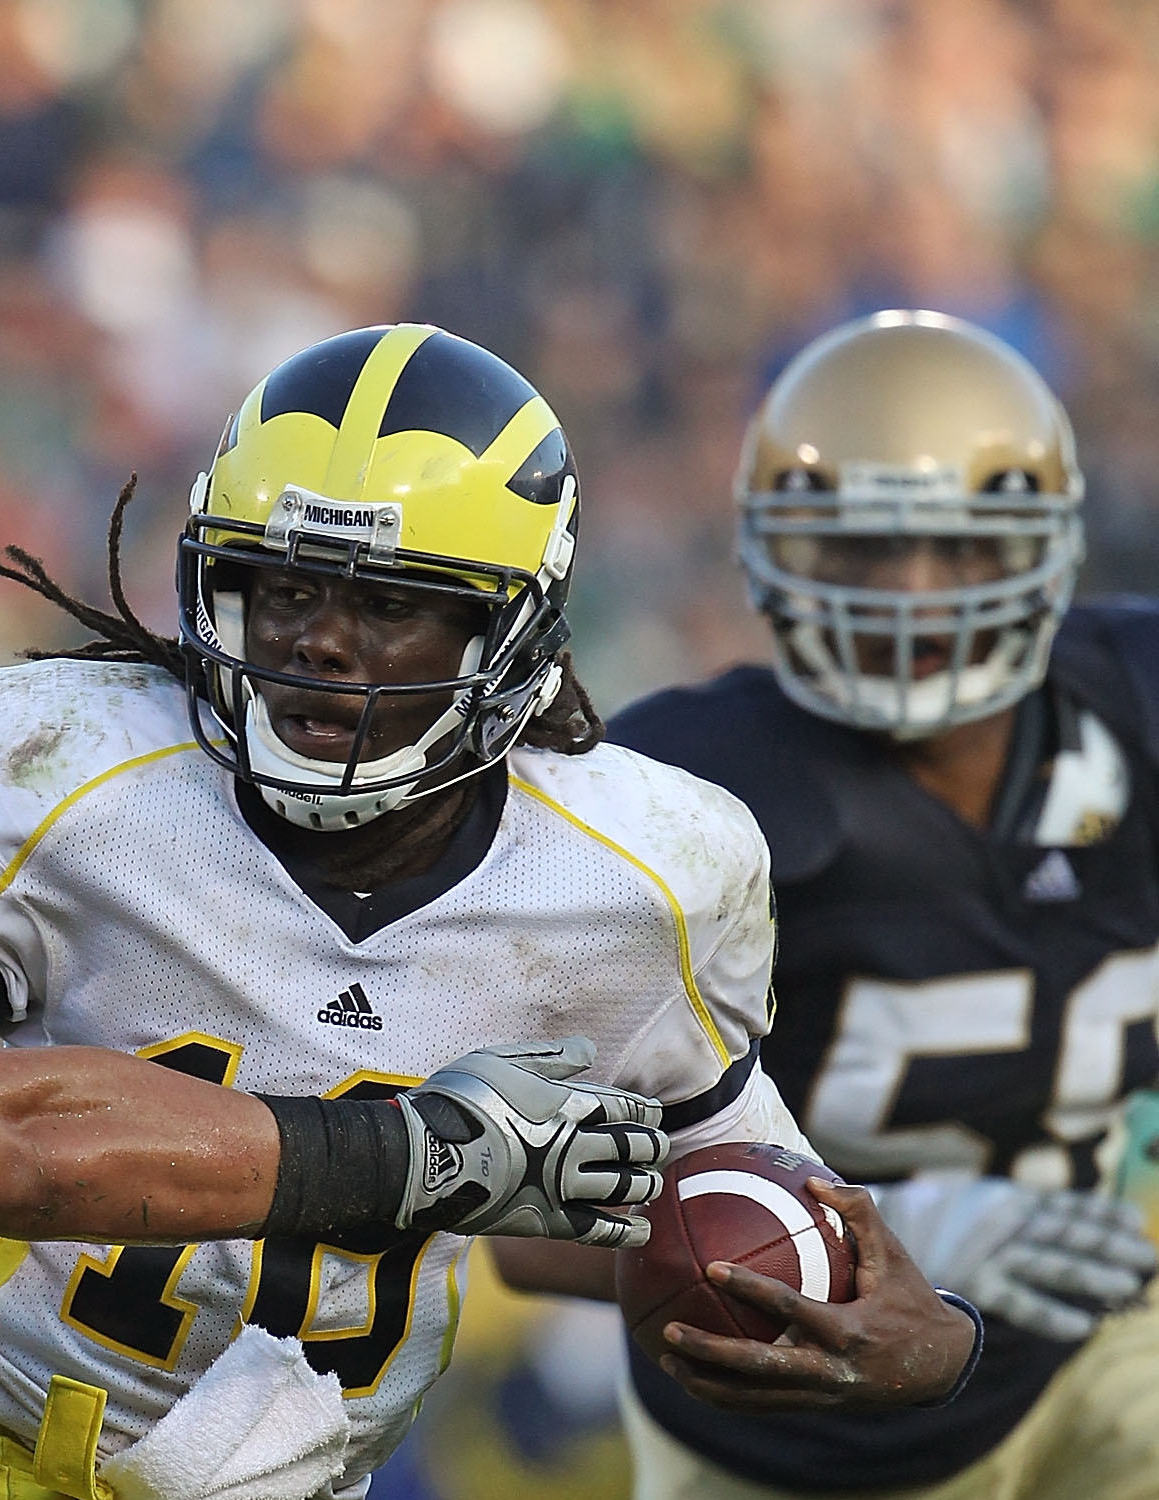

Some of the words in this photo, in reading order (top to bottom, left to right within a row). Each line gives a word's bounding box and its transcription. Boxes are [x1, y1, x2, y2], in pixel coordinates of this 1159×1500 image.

[303, 504, 374, 527] MICHIGAN
[317, 1009, 383, 1031] adidas
[428, 1134, 439, 1183] adidas
[60, 1030, 439, 1399] 16
